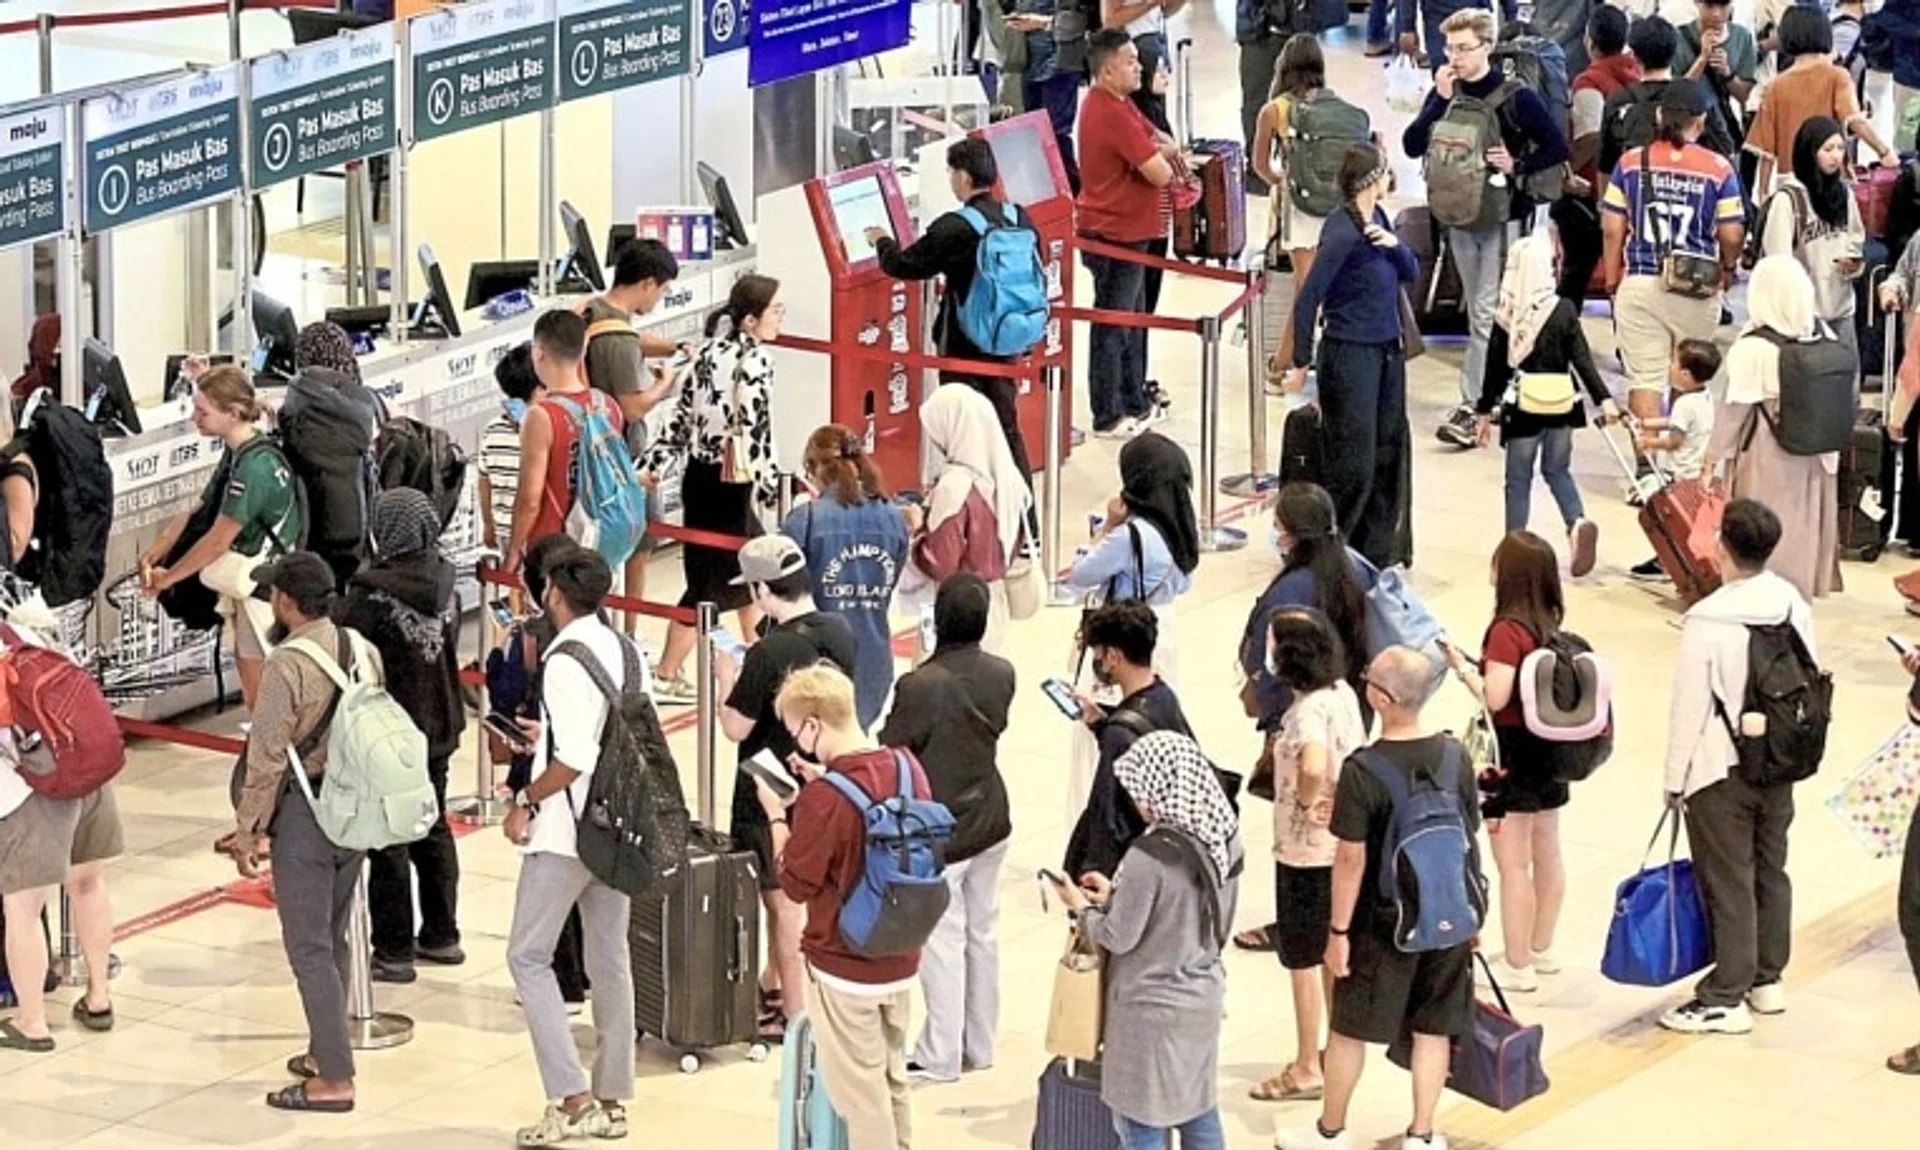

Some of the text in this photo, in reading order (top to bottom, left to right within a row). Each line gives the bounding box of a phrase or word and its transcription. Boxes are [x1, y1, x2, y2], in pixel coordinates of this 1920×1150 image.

[604, 24, 681, 58] Pas Masuk Bas
[460, 57, 545, 95] Pas Masuk Bas
[10, 116, 47, 141] maju
[297, 98, 385, 140] Pas Masuk Bas
[135, 137, 229, 182] Pas Masuk Bas
[298, 123, 385, 162] Bus Boarding Pass
[29, 176, 54, 198] Bas
[135, 162, 229, 206] Bus Boarding Pass
[28, 200, 55, 220] Pass
[1643, 201, 1695, 246] 67
[822, 558, 842, 583] THE
